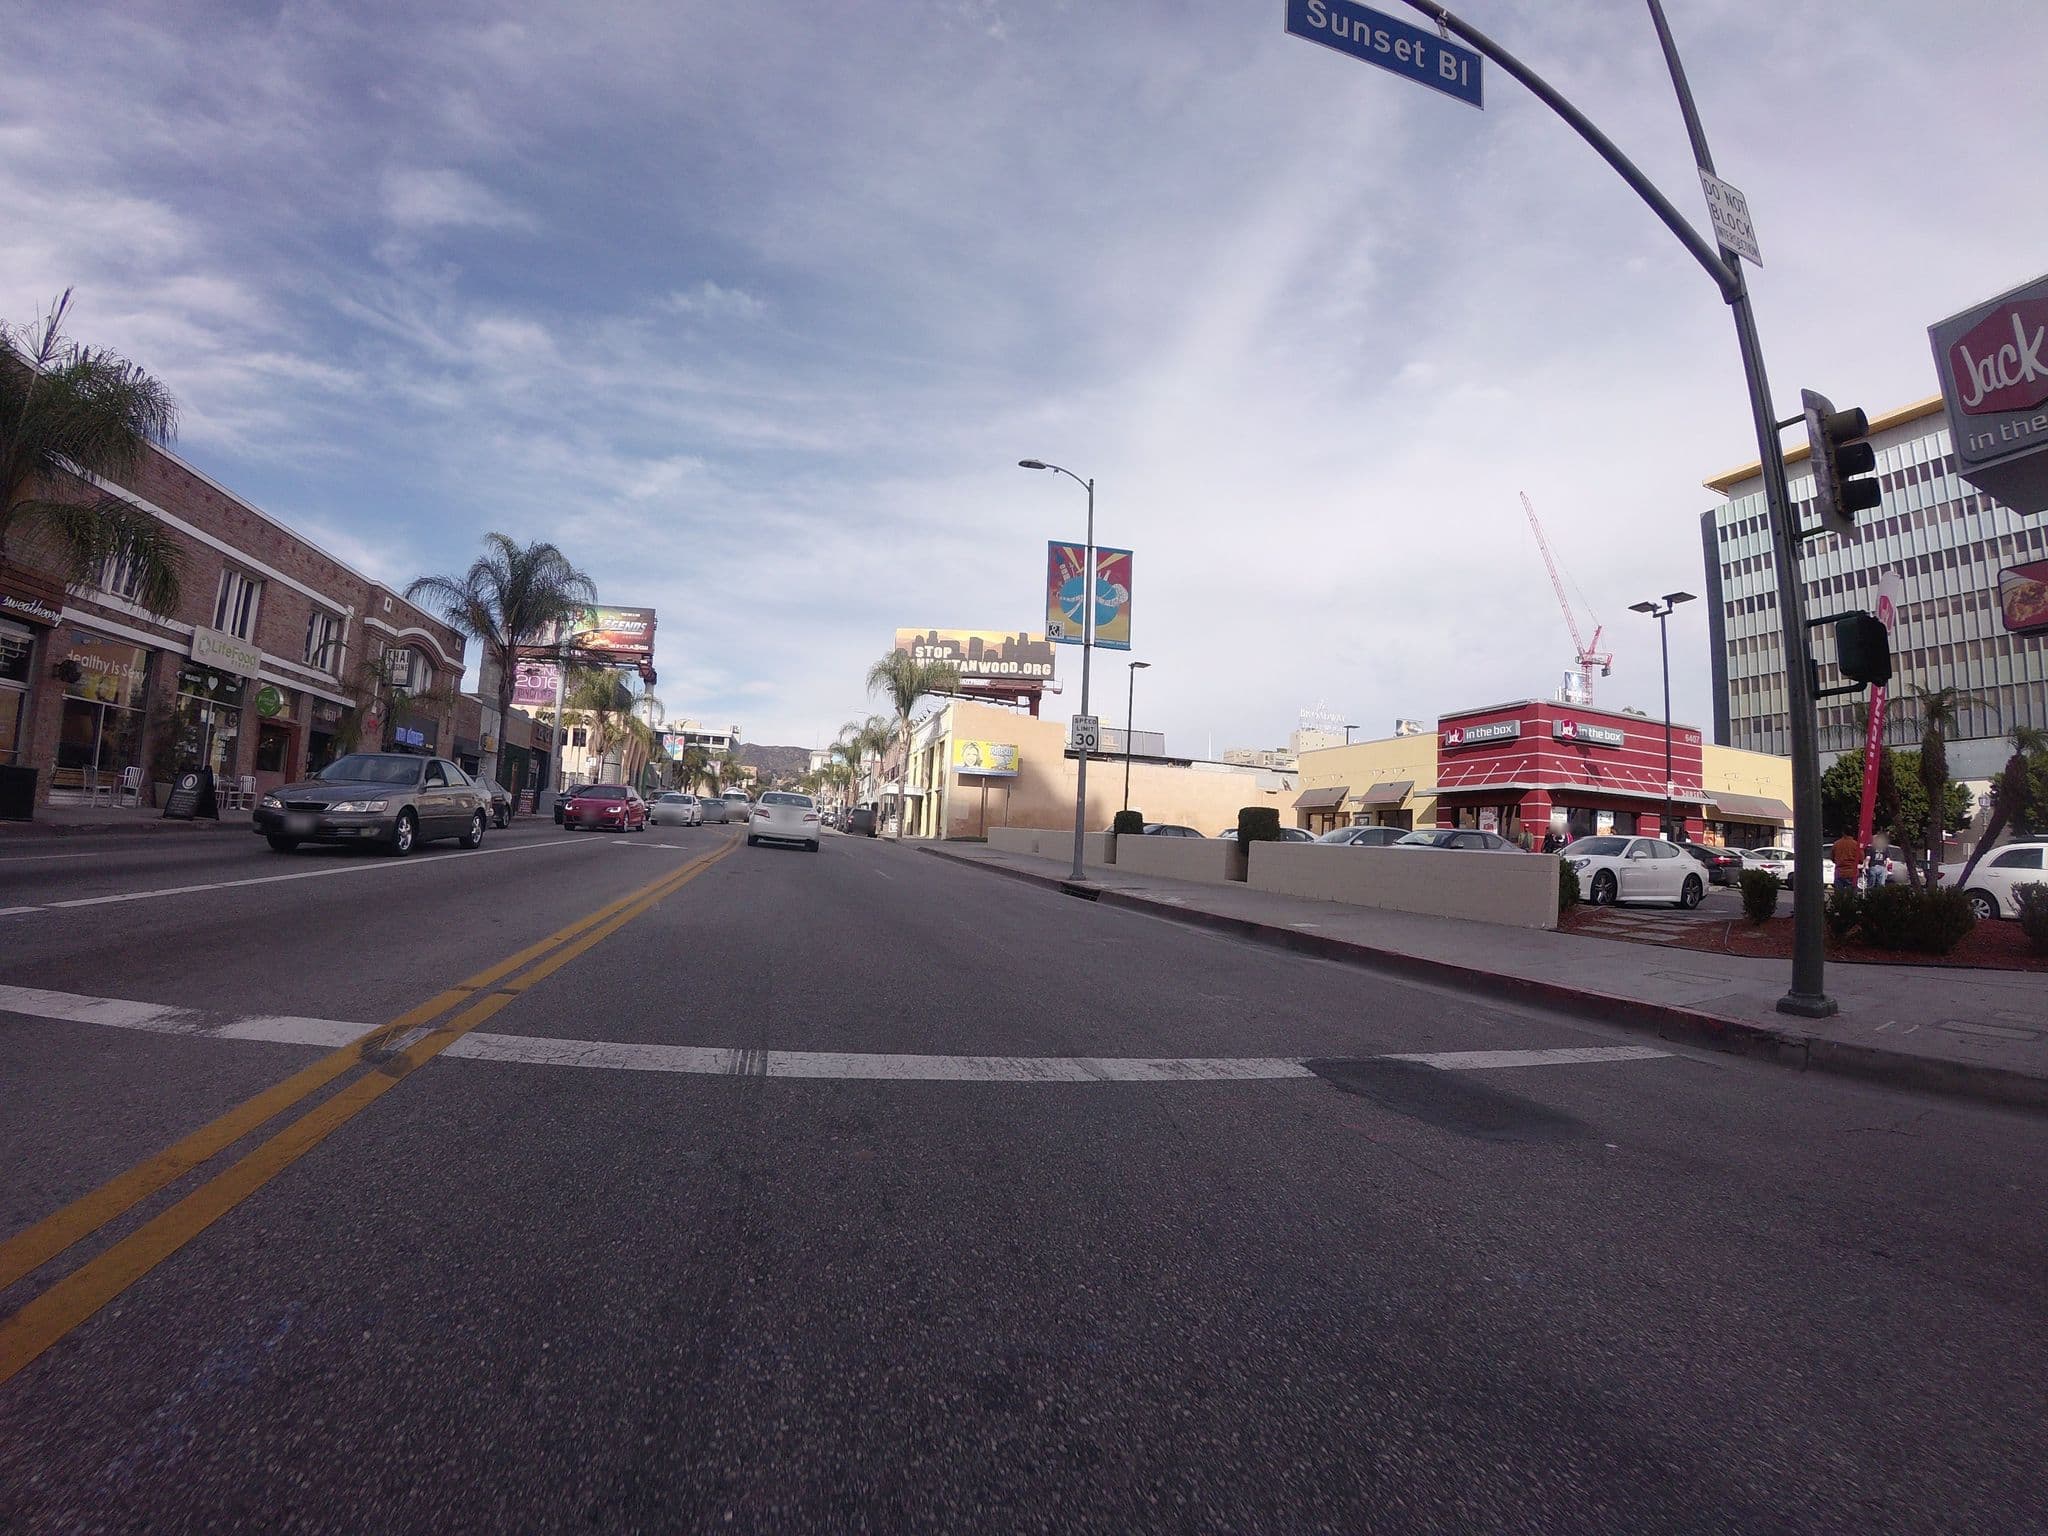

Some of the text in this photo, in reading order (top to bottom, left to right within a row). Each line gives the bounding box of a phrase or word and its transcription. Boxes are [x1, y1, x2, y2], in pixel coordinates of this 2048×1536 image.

[1306, 0, 1468, 86] Sunset Bl
[1703, 179, 1746, 216] DO NOT
[1710, 202, 1754, 241] BLOCK
[1959, 312, 2048, 407] Jack
[1969, 415, 2048, 451] in the
[212, 641, 256, 665] LifeFood
[388, 650, 410, 663] THAI
[915, 645, 952, 659] STOP
[121, 663, 147, 680] Sexy
[514, 674, 559, 689] 2016
[1075, 717, 1097, 725] SPEED
[1075, 733, 1095, 746] 30
[1466, 729, 1476, 739] in
[1476, 726, 1492, 738] the
[1493, 724, 1512, 735] box
[1588, 727, 1604, 739] the
[1604, 730, 1621, 742] box
